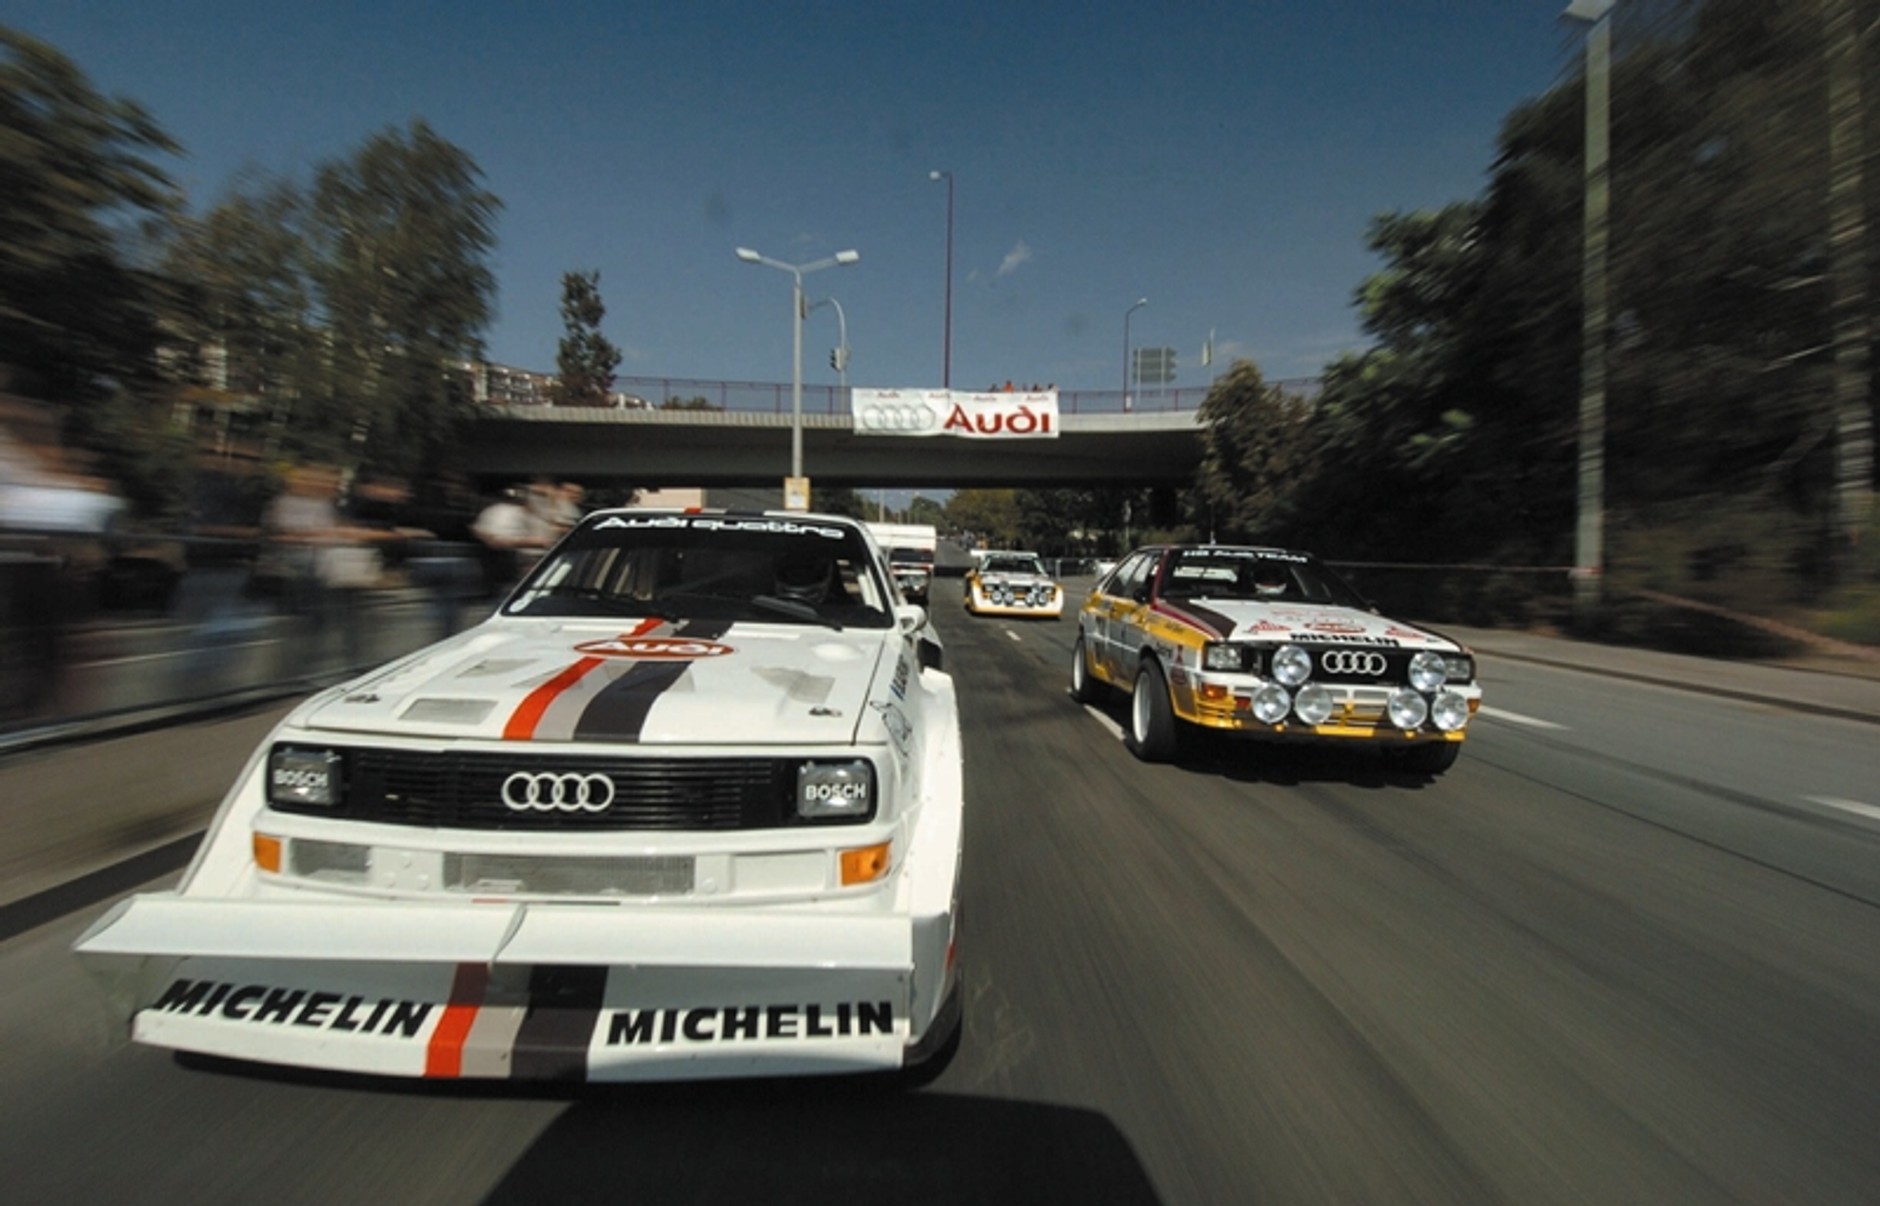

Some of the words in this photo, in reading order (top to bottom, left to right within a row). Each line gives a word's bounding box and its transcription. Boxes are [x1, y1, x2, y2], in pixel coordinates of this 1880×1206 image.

[943, 403, 1050, 434] Audi
[593, 516, 688, 530] Audi
[691, 518, 845, 540] quattro
[1290, 632, 1400, 648] MICHELIN
[273, 768, 329, 788] BOSCH
[805, 782, 867, 801] BOSCH
[152, 978, 434, 1039] MICHELIN
[606, 1001, 895, 1046] MICHELIN
